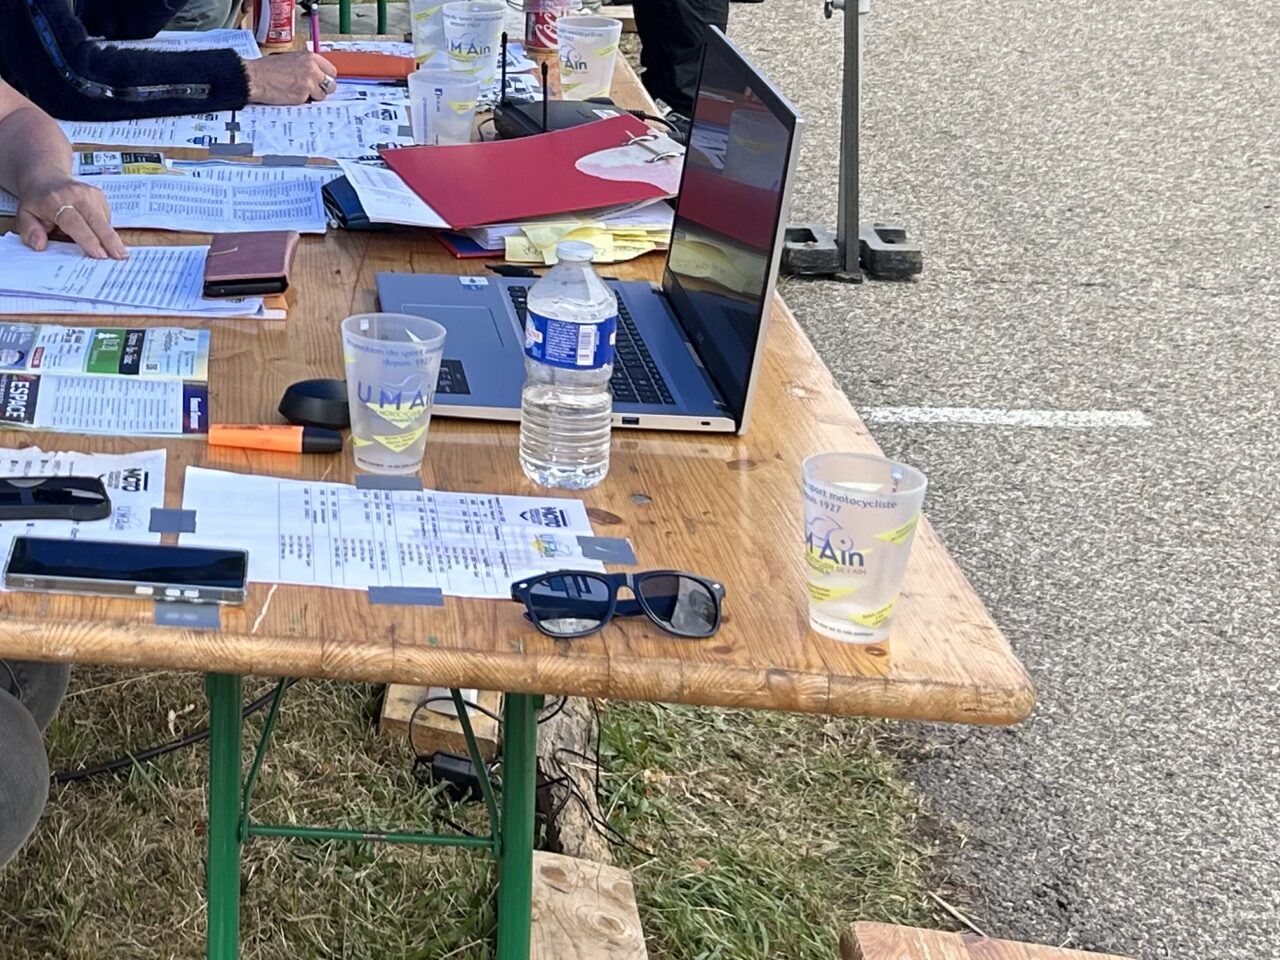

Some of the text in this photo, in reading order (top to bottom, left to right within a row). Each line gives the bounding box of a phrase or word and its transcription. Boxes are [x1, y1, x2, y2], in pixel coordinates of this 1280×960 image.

[565, 57, 587, 70] Ain
[5, 381, 30, 418] ESPACE
[121, 467, 142, 492] MOTO
[819, 500, 842, 514] 1927
[829, 492, 898, 510] motocycliste
[819, 536, 865, 567] Ain
